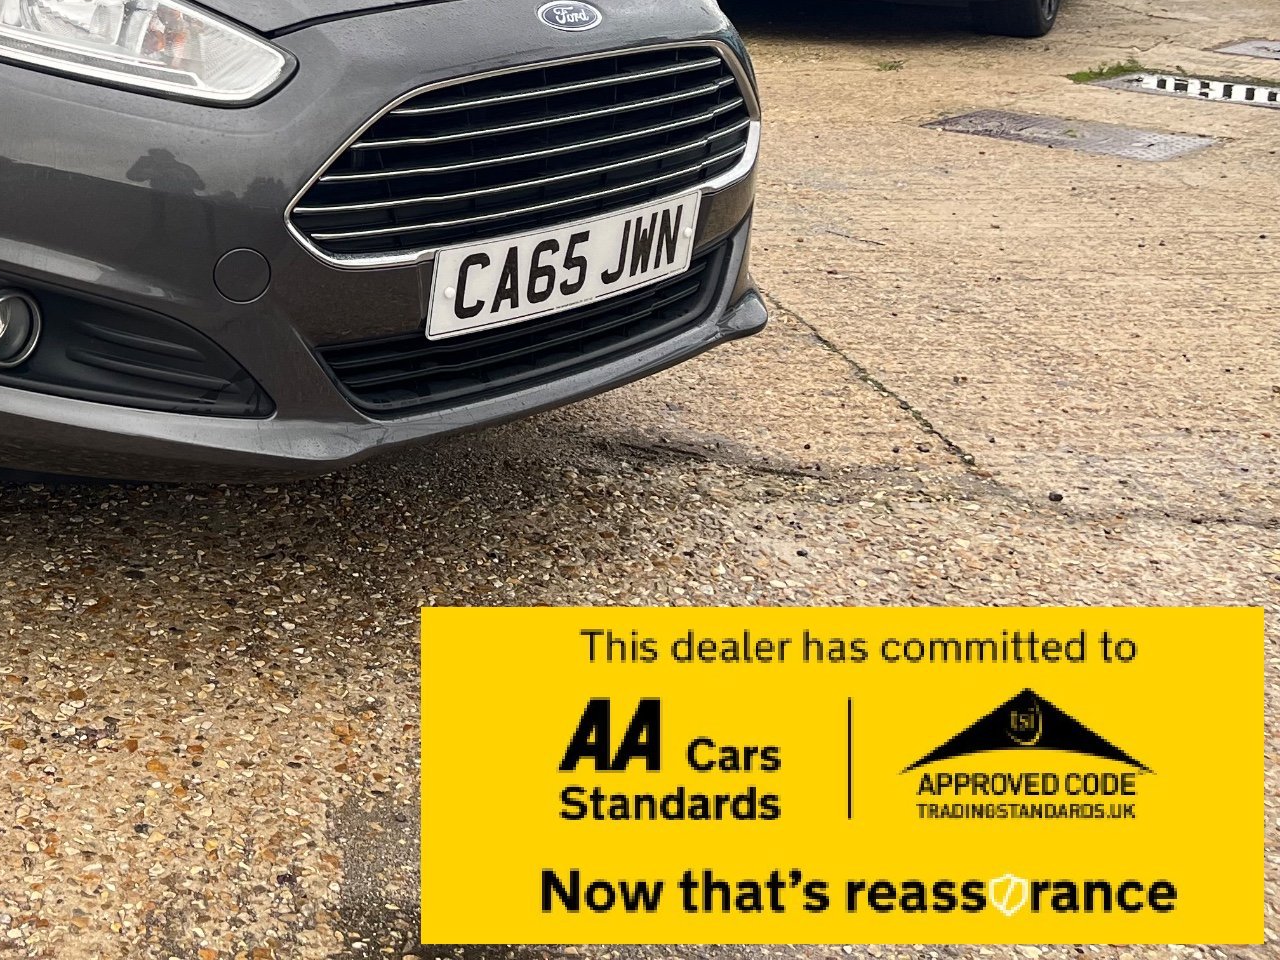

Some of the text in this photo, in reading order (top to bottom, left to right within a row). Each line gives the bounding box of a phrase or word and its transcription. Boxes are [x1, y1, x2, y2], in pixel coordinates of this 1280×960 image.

[552, 6, 590, 25] Ford
[454, 204, 684, 320] CA65 JWN
